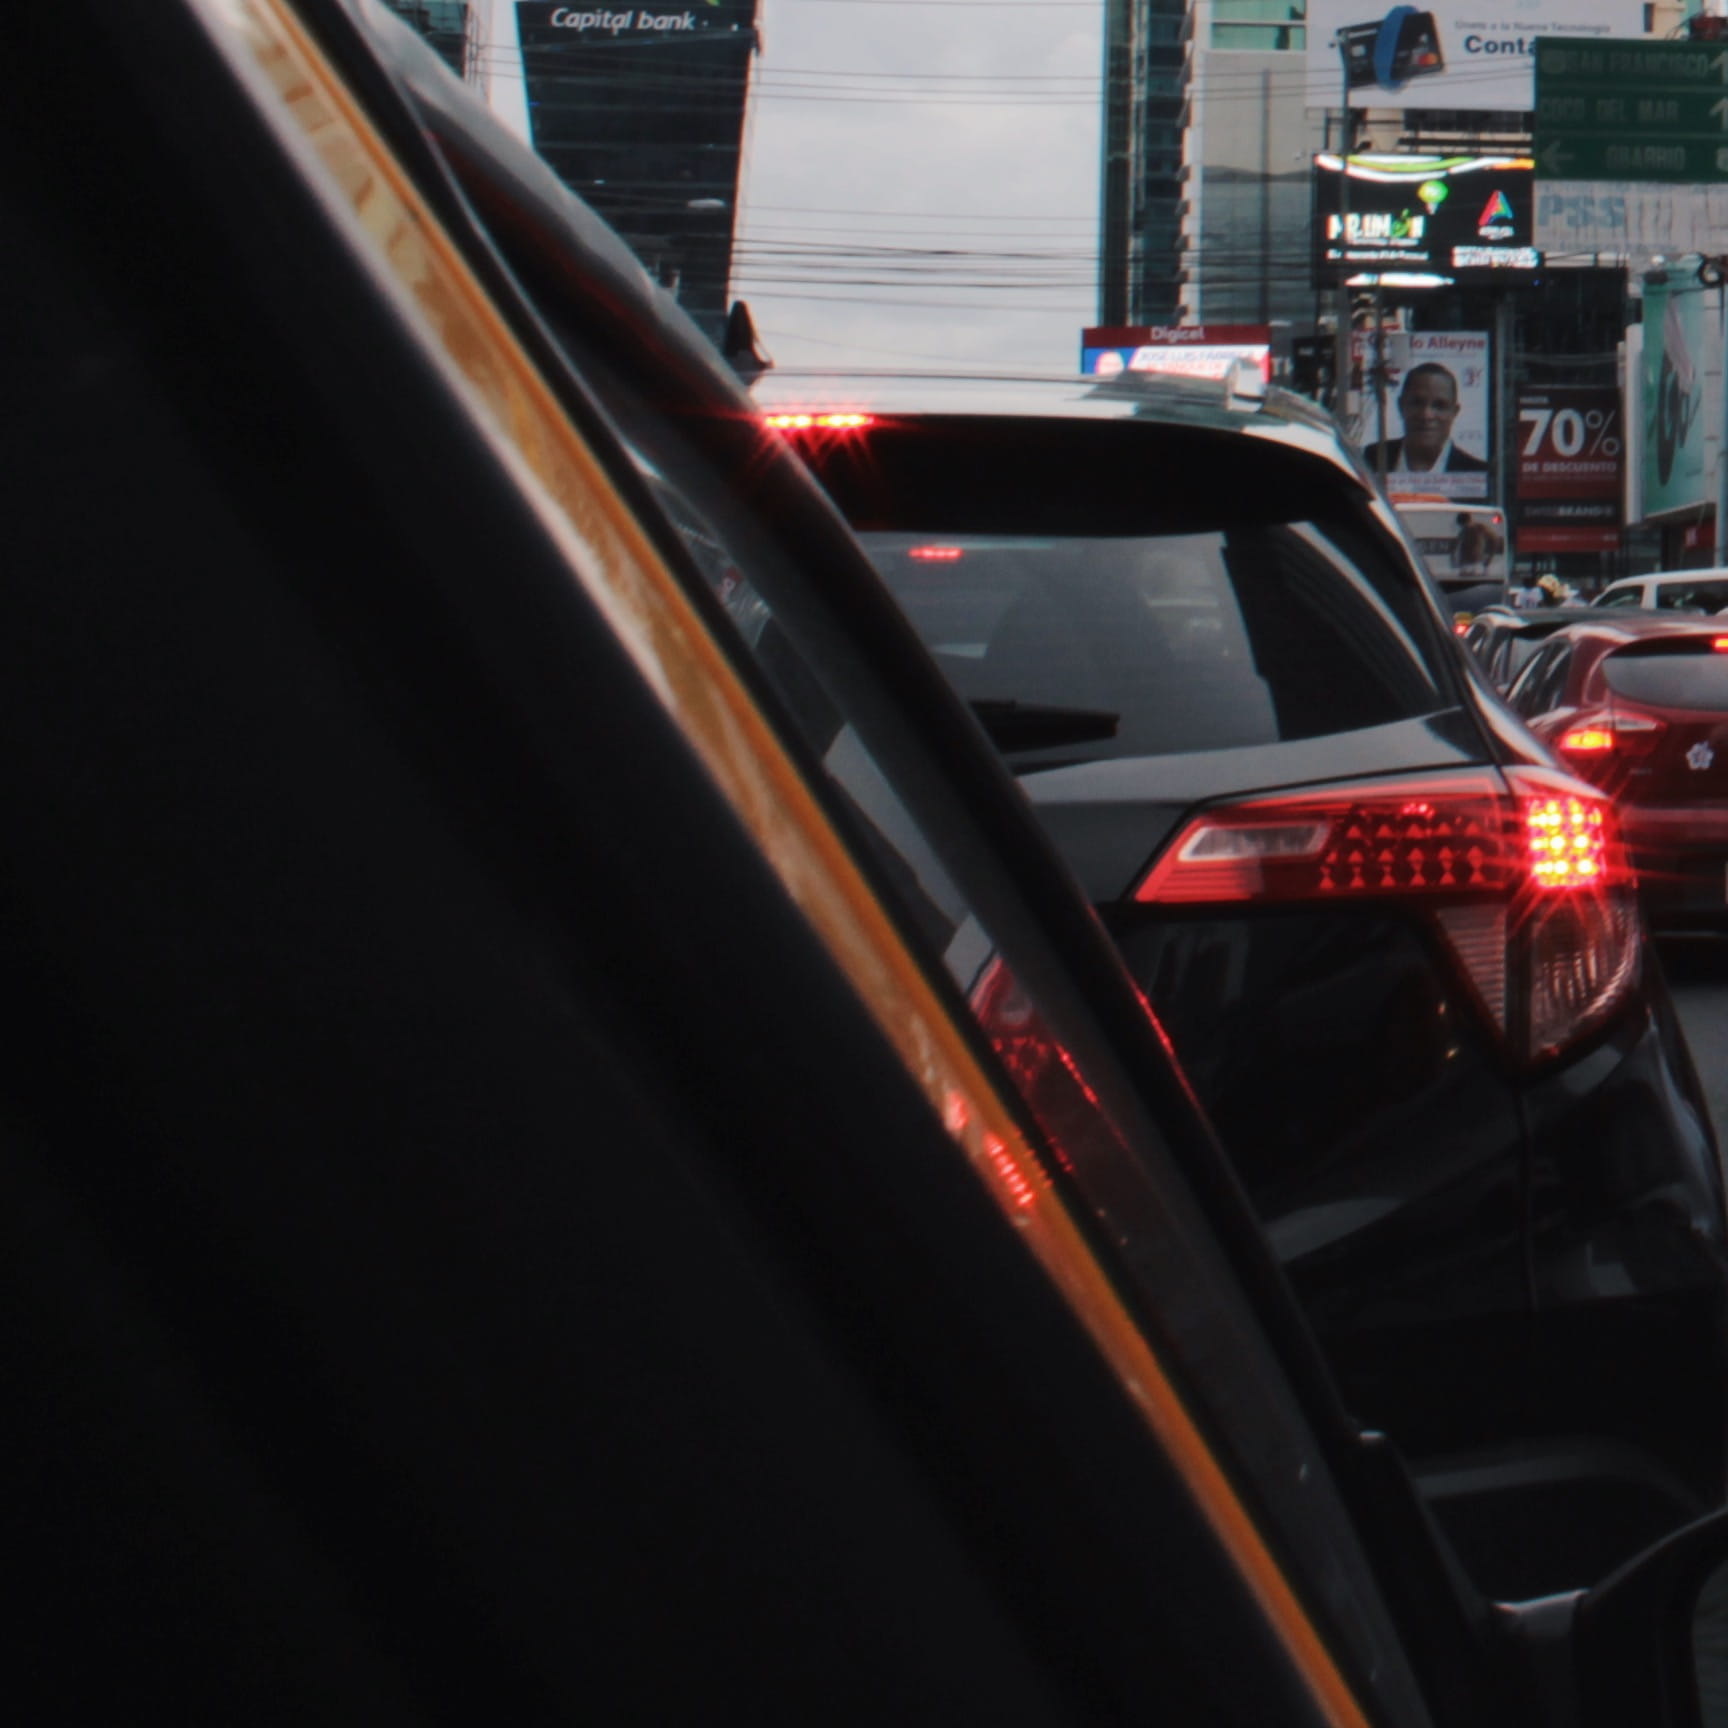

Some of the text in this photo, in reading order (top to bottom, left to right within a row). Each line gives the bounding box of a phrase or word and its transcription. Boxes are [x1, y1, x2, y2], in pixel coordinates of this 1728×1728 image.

[550, 7, 696, 33] Capital bank
[1608, 52, 1709, 78] FRANCISCO
[1151, 325, 1205, 343] Digicel
[1427, 335, 1486, 352] Alleyne
[1519, 407, 1621, 458] 70%
[1522, 461, 1618, 473] DE DESCUENTO
